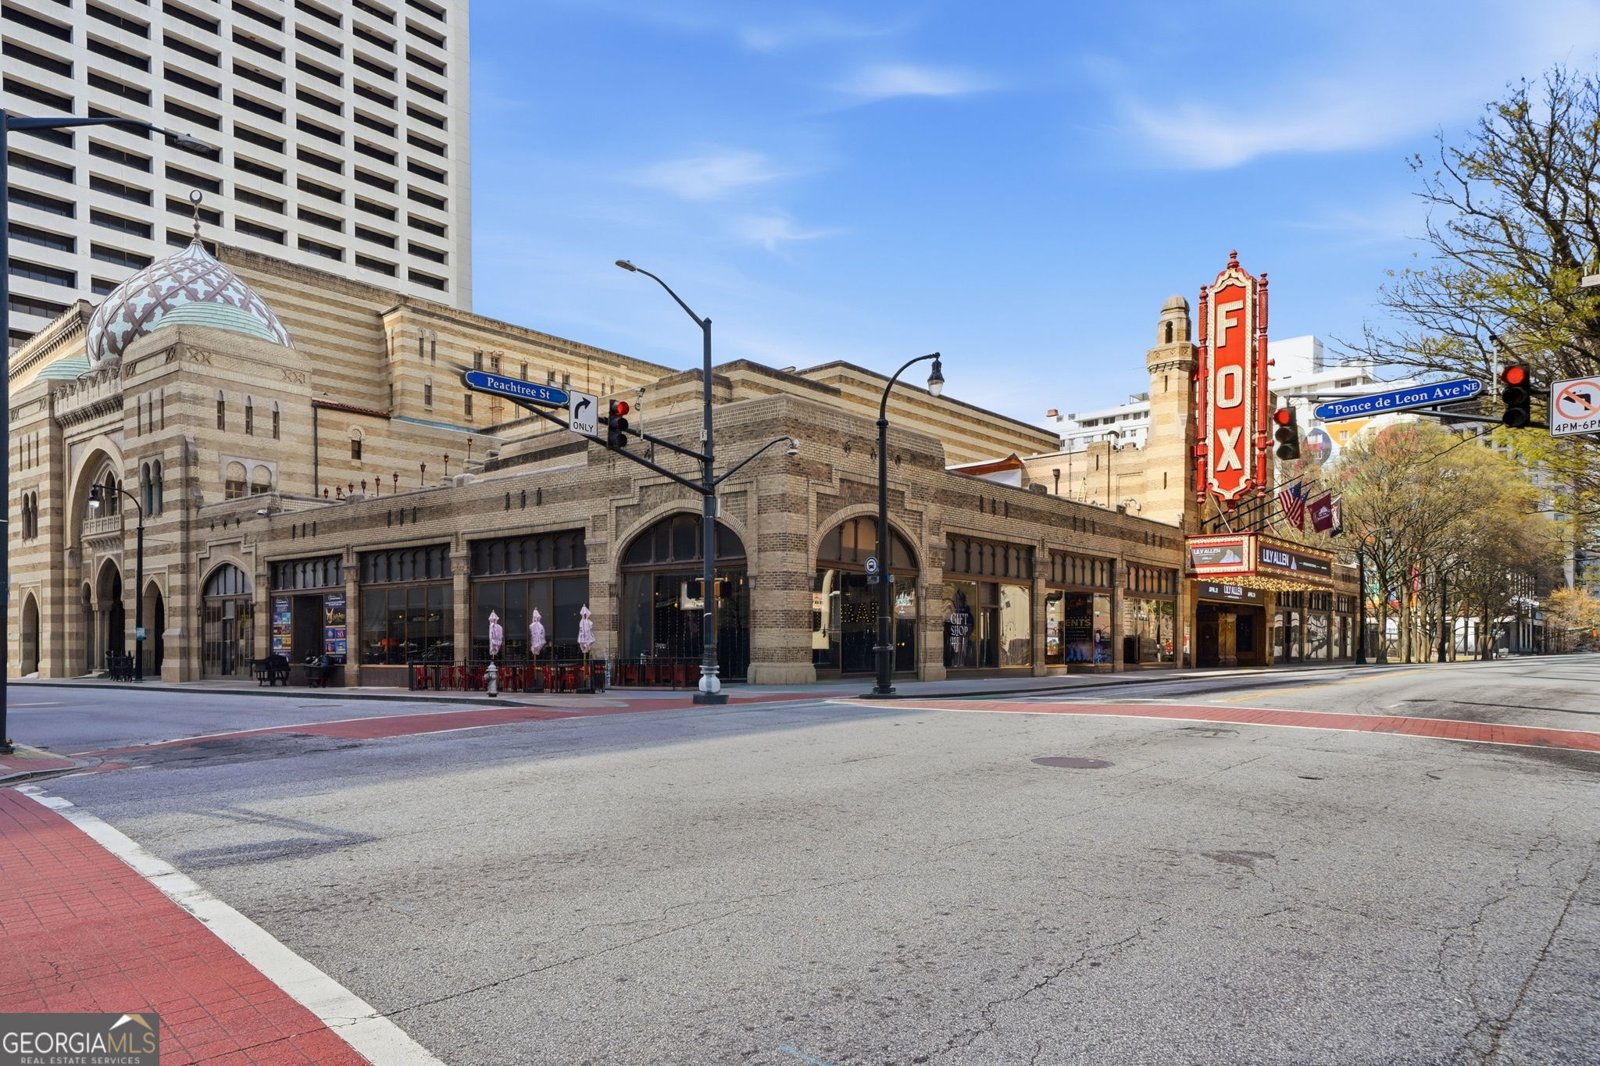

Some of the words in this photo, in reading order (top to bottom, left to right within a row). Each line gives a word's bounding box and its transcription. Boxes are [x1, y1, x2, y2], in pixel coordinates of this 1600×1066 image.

[487, 376, 537, 396] Peachtree
[539, 389, 550, 399] St
[1215, 300, 1244, 472] FOX
[1334, 402, 1371, 415] Ponce
[1375, 397, 1391, 408] de
[1395, 392, 1428, 405] Leon
[1433, 387, 1460, 399] Ave
[1462, 382, 1478, 392] NE
[573, 421, 594, 433] ONLY
[950, 612, 968, 625] GIFT
[950, 625, 968, 637] SHOP
